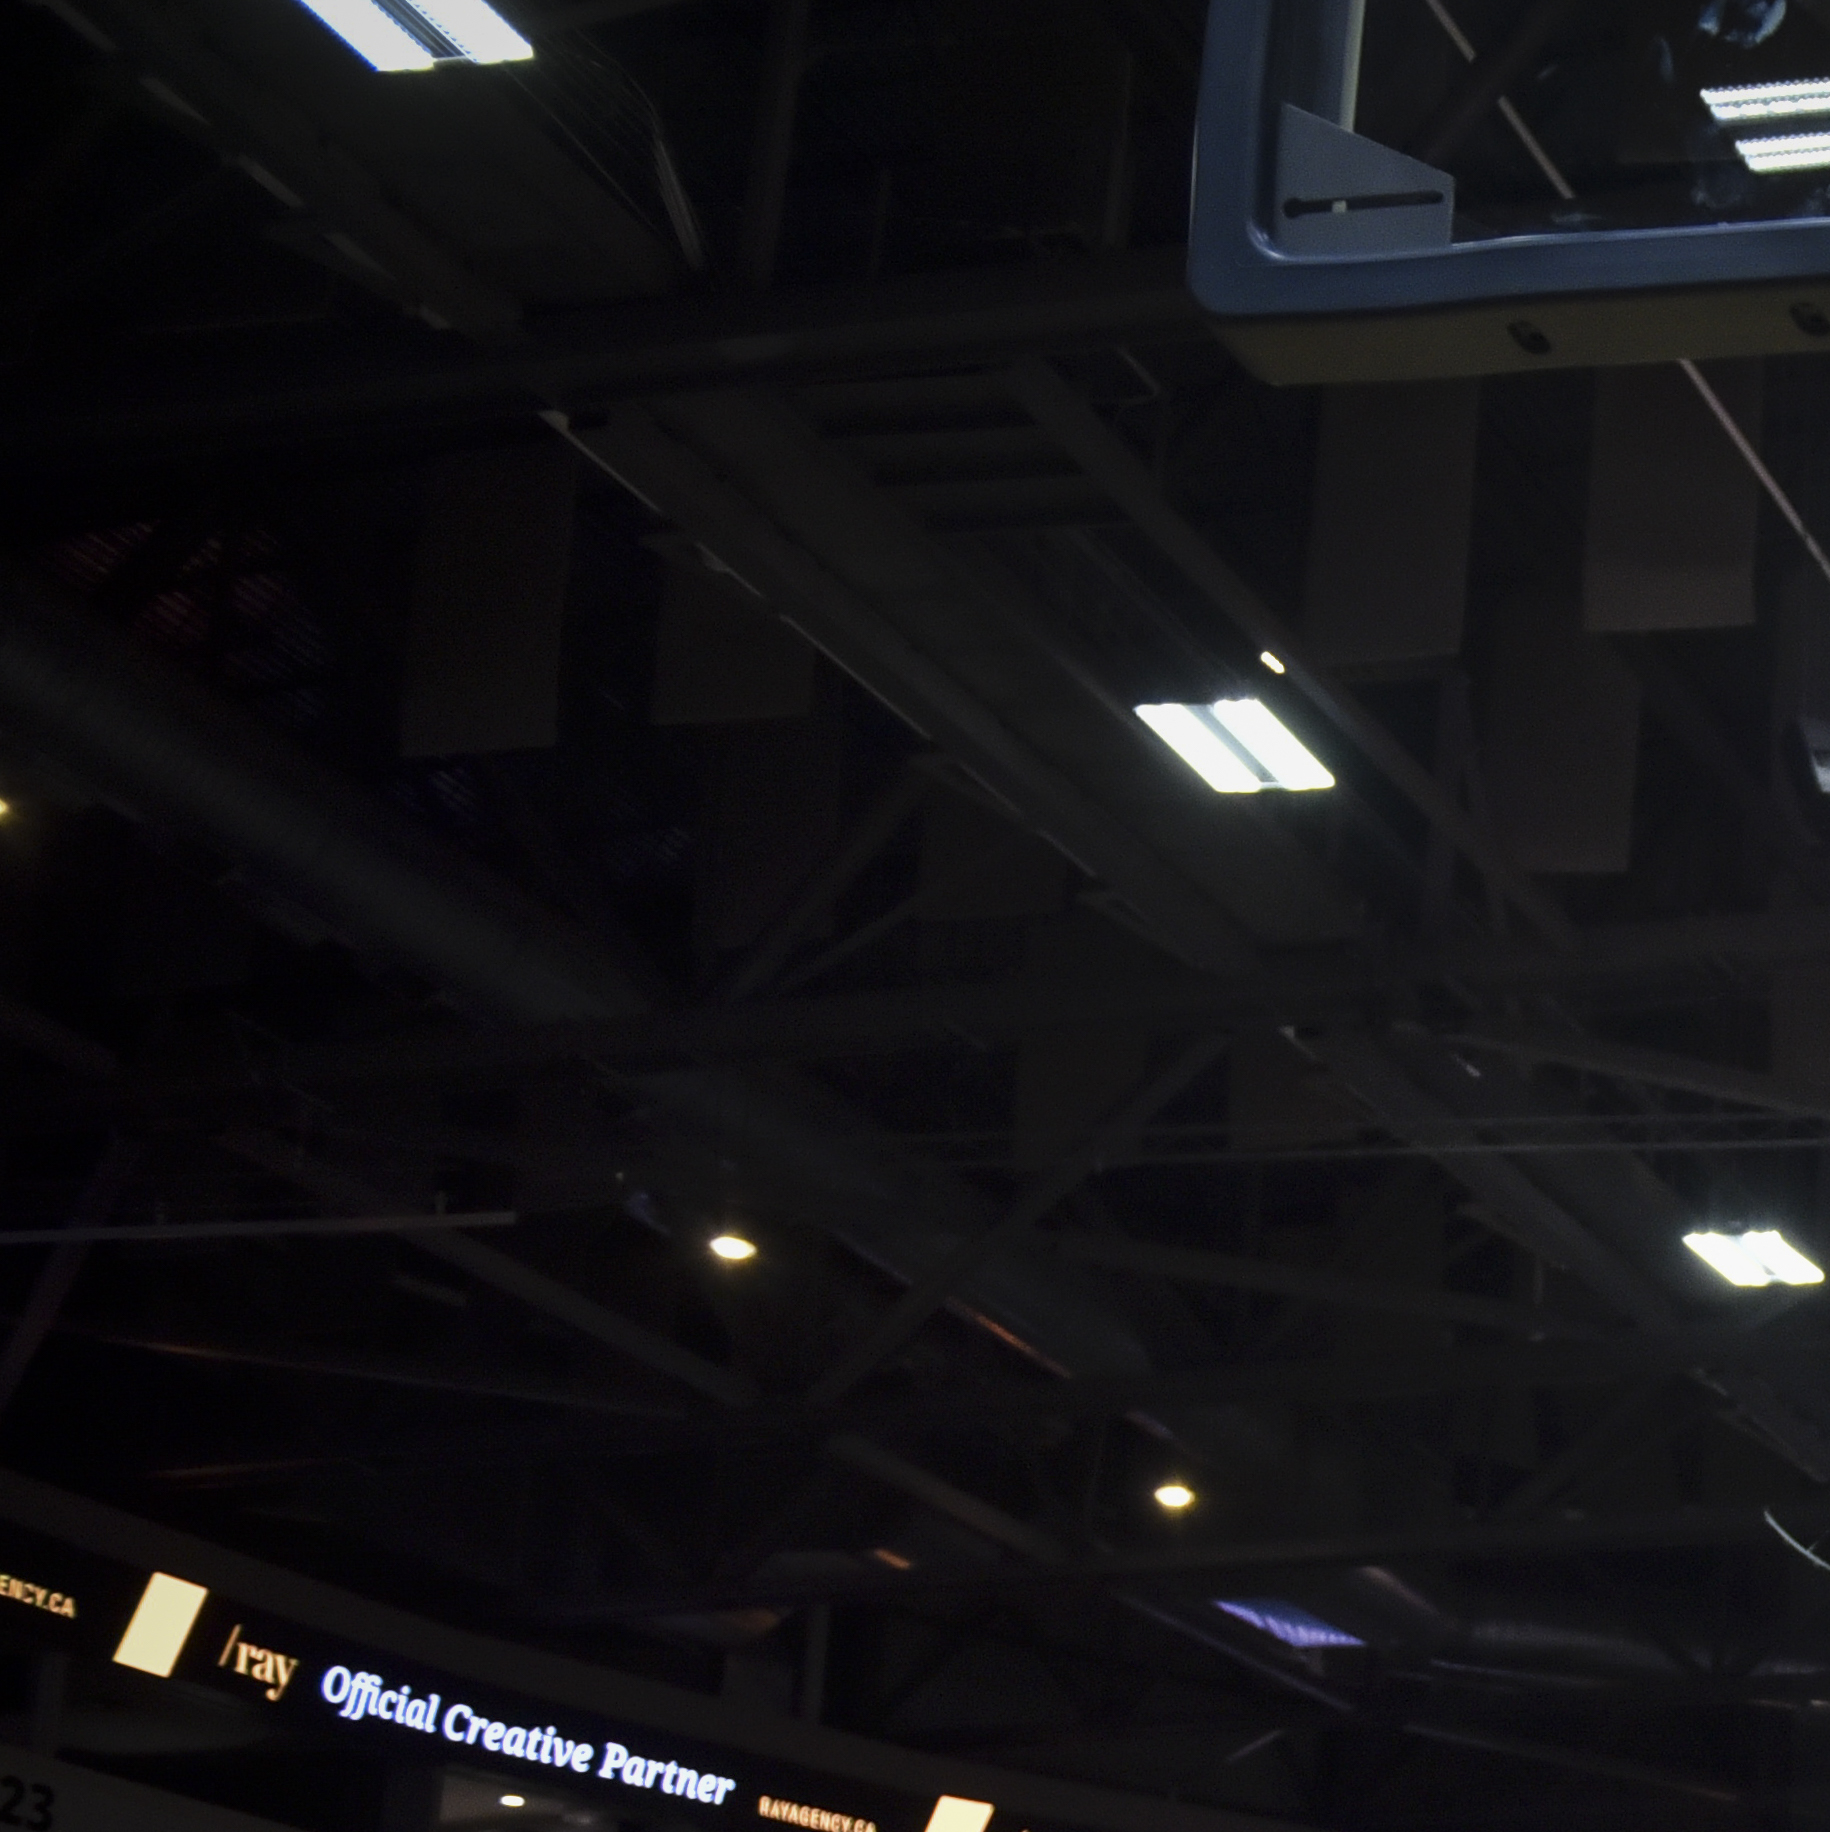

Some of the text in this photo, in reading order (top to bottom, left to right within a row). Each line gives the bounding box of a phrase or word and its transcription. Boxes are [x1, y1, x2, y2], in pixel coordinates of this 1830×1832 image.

[320, 1665, 736, 1805] Official Creative Partner
